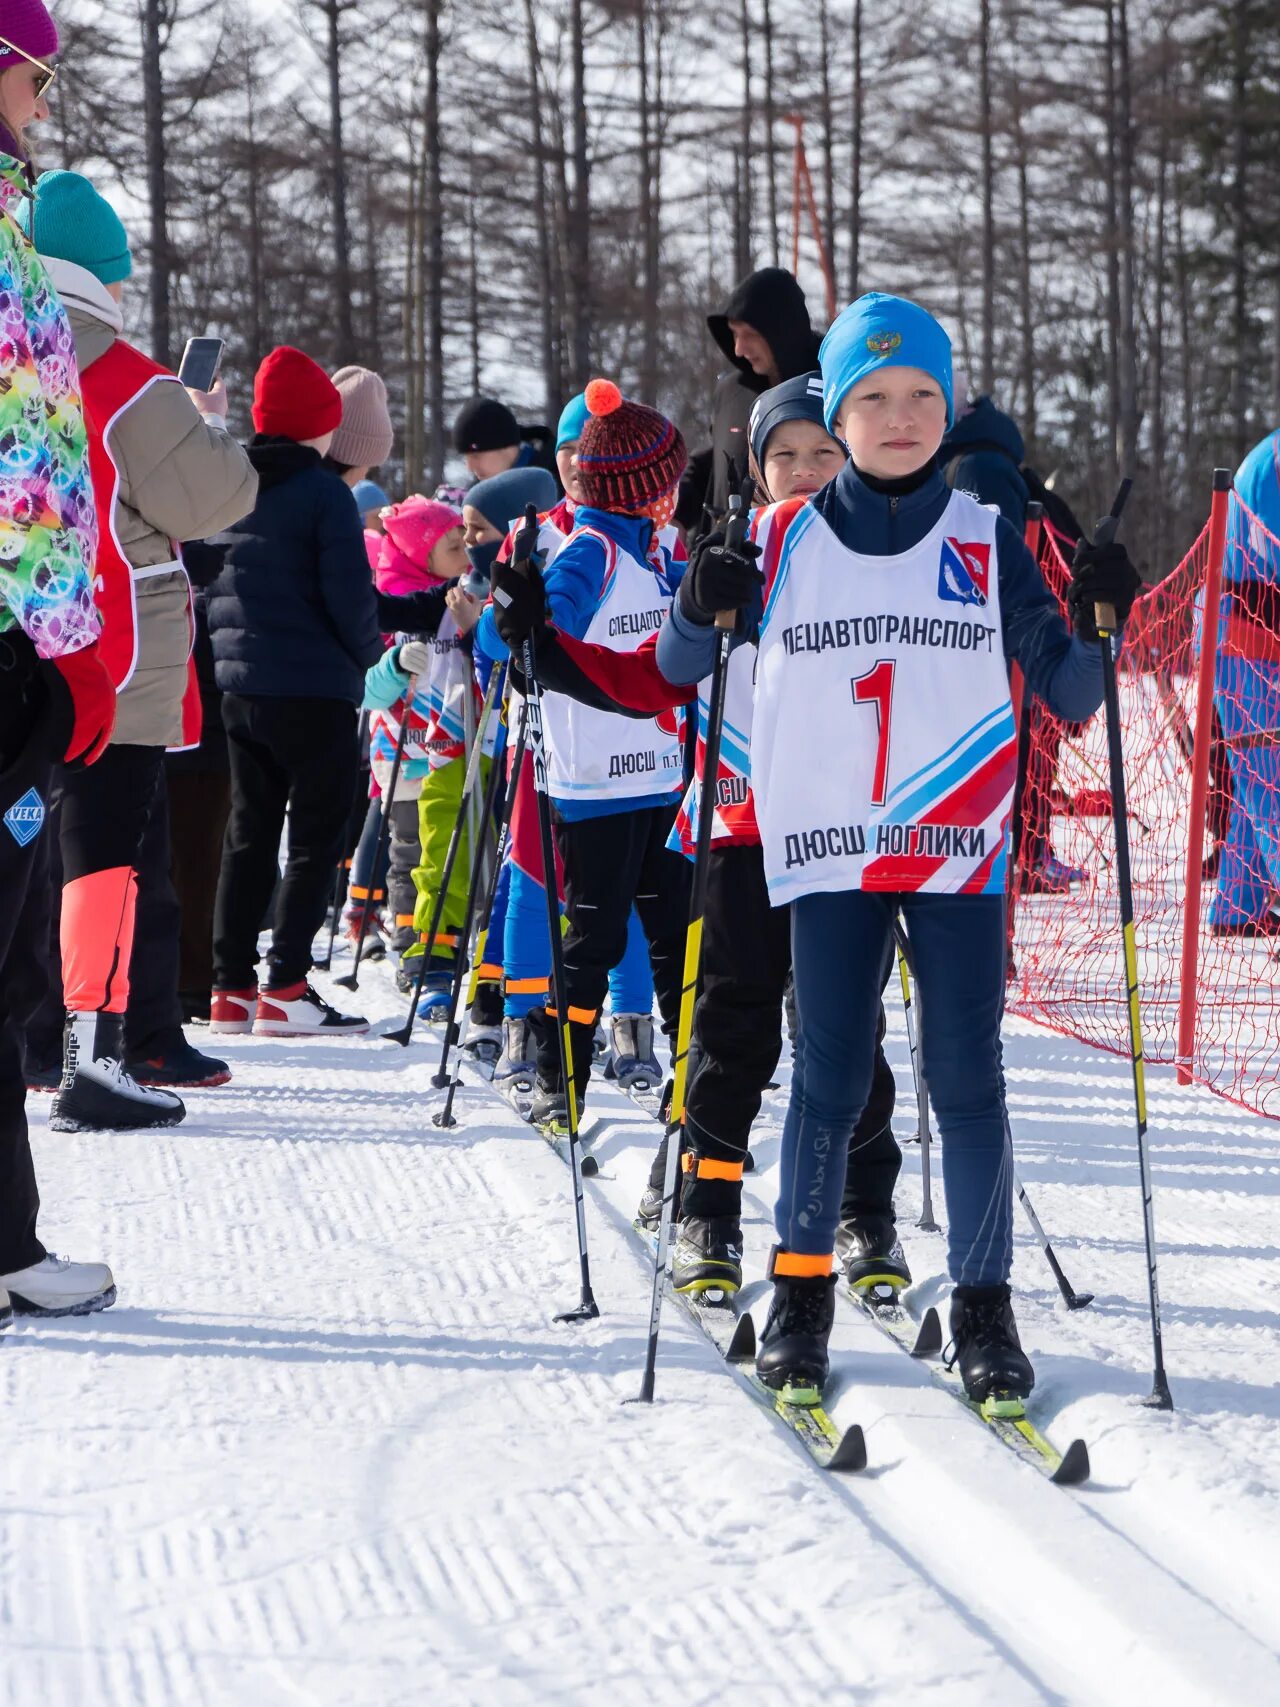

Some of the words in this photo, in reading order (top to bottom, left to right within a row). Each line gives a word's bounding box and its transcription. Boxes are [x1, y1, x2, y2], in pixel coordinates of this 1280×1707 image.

[782, 615, 997, 656] ПЕЦАВТОТРАНСПОРТ
[851, 659, 897, 807] 1
[608, 751, 656, 779] ДЮСШ
[784, 825, 866, 869] ДЮСШ
[875, 825, 985, 858] НОГЛИКИ
[64, 1033, 81, 1089] alpina
